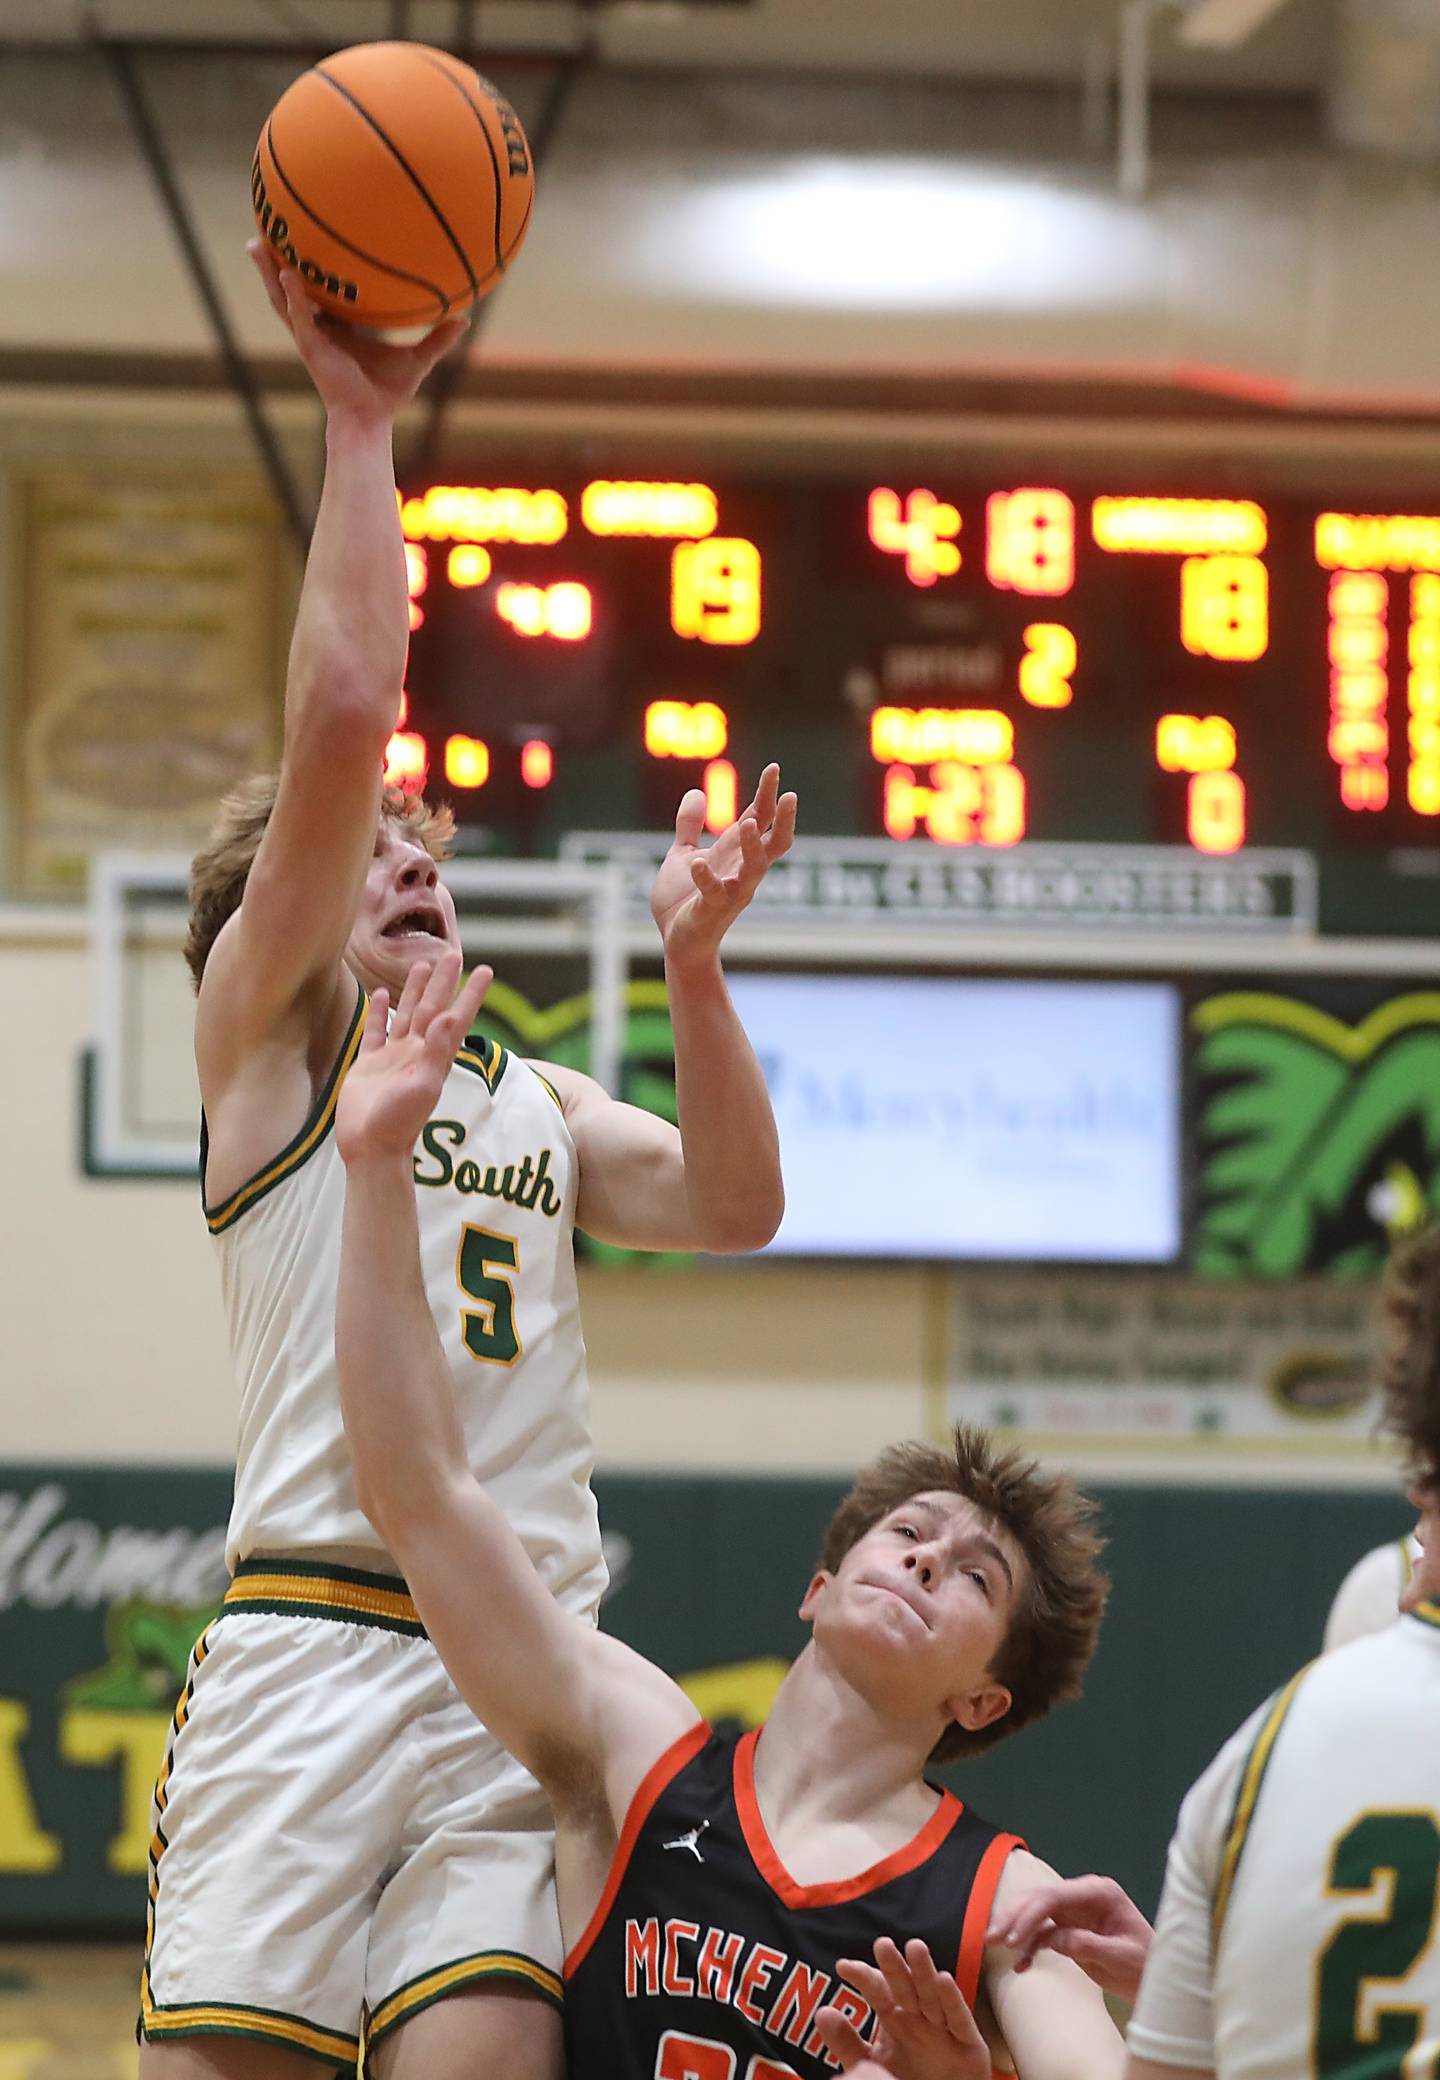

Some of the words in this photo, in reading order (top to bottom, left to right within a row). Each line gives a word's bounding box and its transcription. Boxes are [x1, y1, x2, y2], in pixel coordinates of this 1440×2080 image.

[1019, 623, 1077, 708] 2
[413, 1119, 562, 1218] South
[456, 1220, 523, 1368] 5
[625, 1916, 882, 2070] MCHENR
